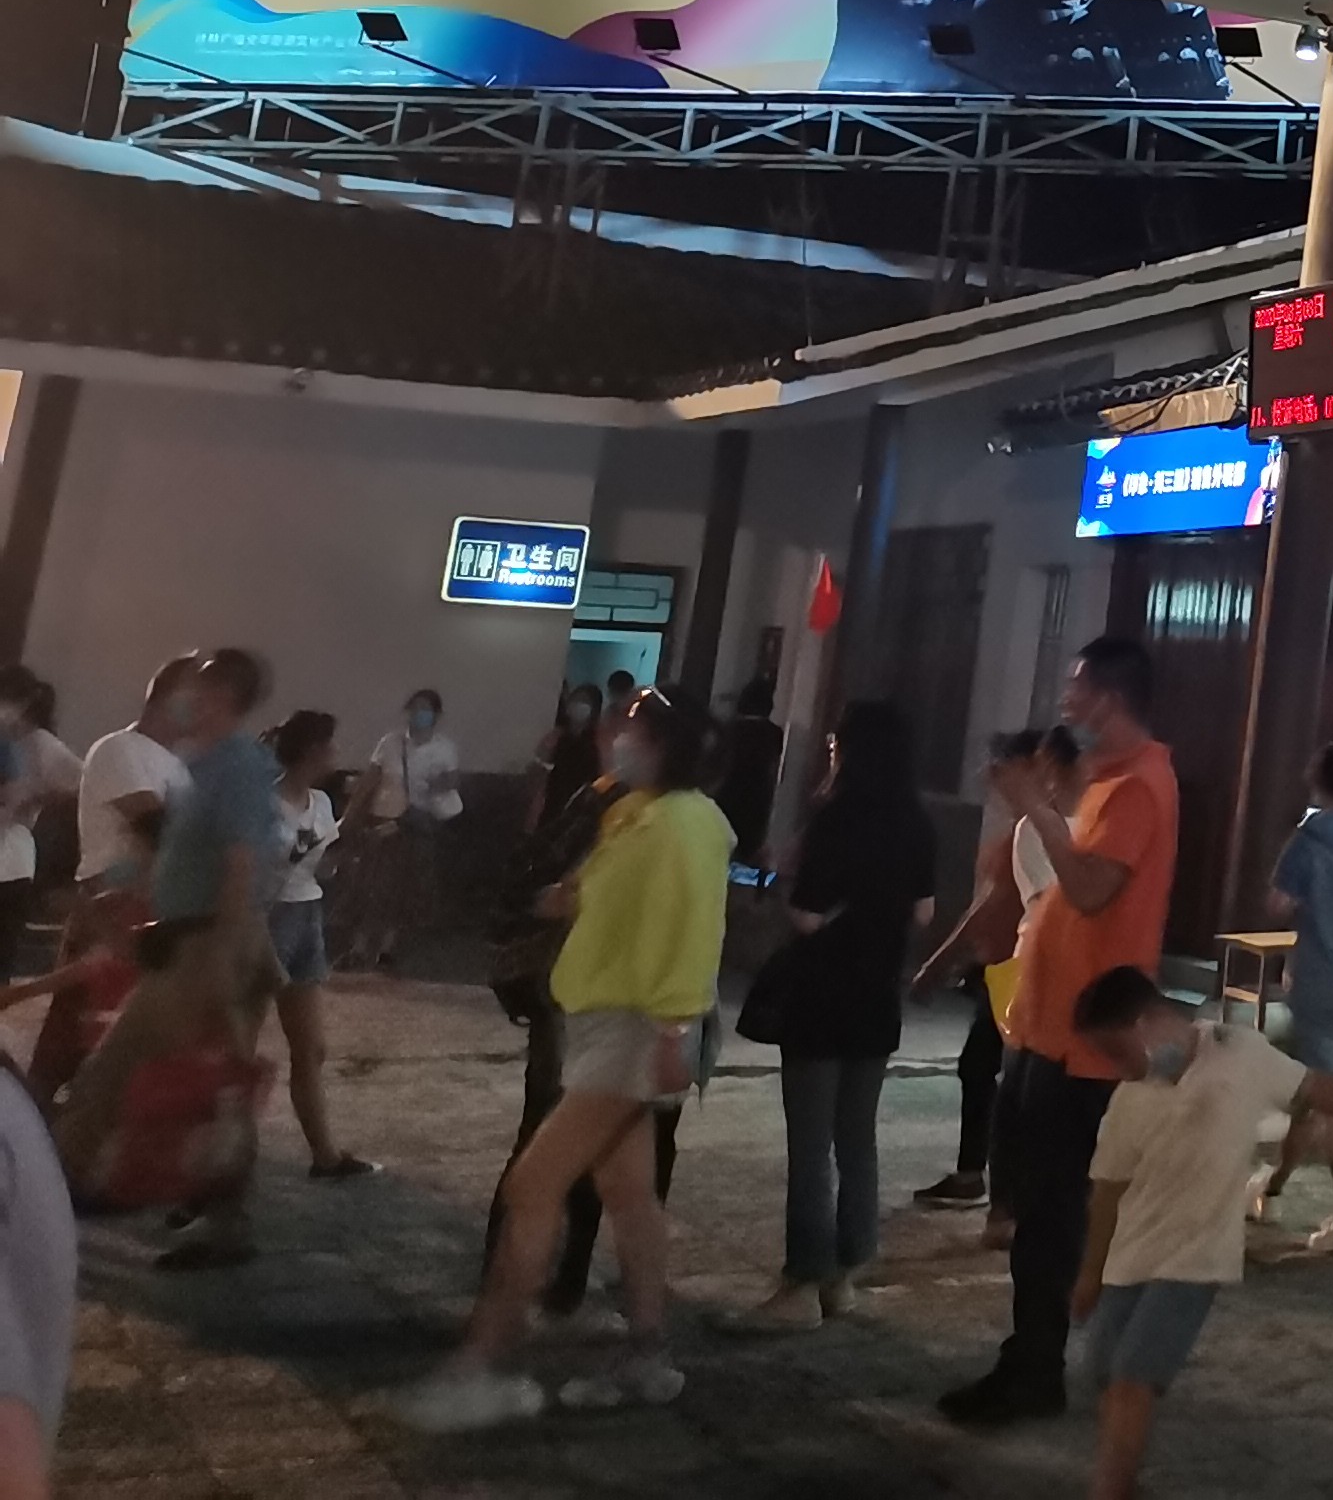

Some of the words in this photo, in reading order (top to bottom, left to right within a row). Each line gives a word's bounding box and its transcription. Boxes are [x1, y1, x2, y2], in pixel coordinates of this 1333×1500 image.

[501, 544, 580, 572] 卫生间
[498, 568, 576, 588] Restrooms
